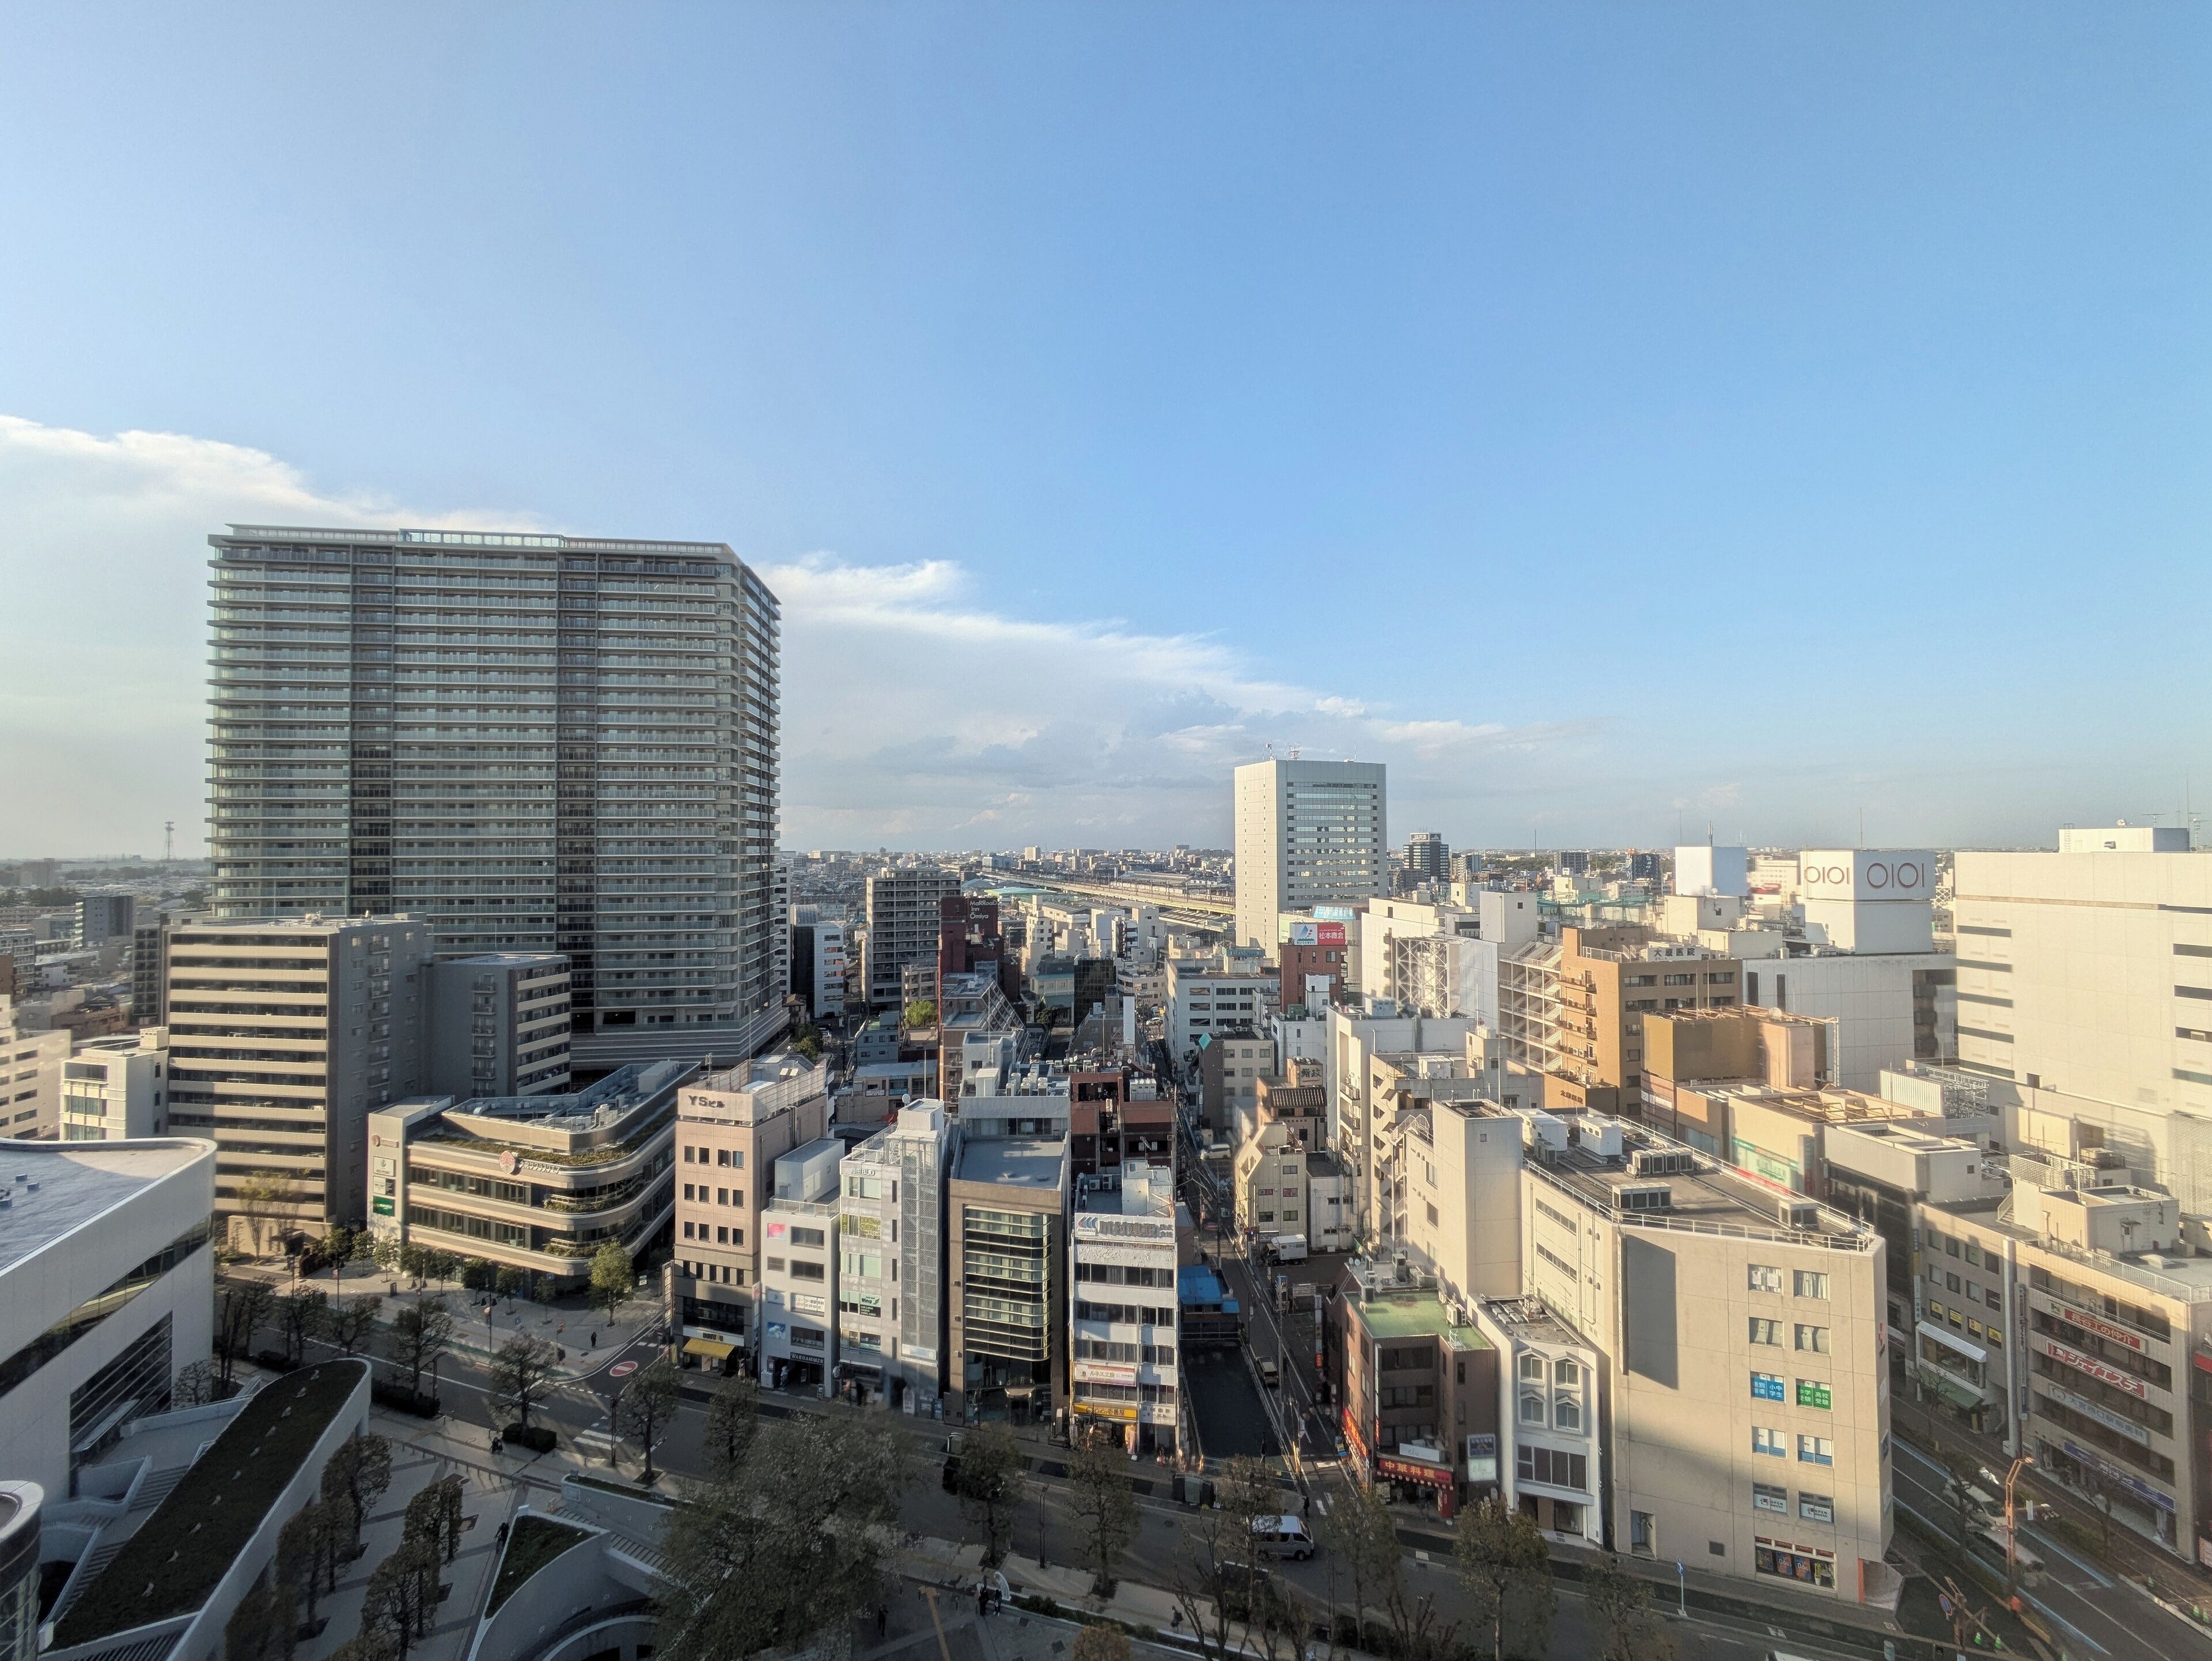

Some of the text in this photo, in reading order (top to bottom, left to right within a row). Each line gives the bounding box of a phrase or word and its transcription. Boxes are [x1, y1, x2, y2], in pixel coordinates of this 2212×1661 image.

[688, 1095, 725, 1108] YSビル
[2071, 1313, 2133, 1344] 長谷工の仲介
[791, 1353, 824, 1364] WARHAMMER
[1385, 1461, 1435, 1478] 中華料理
